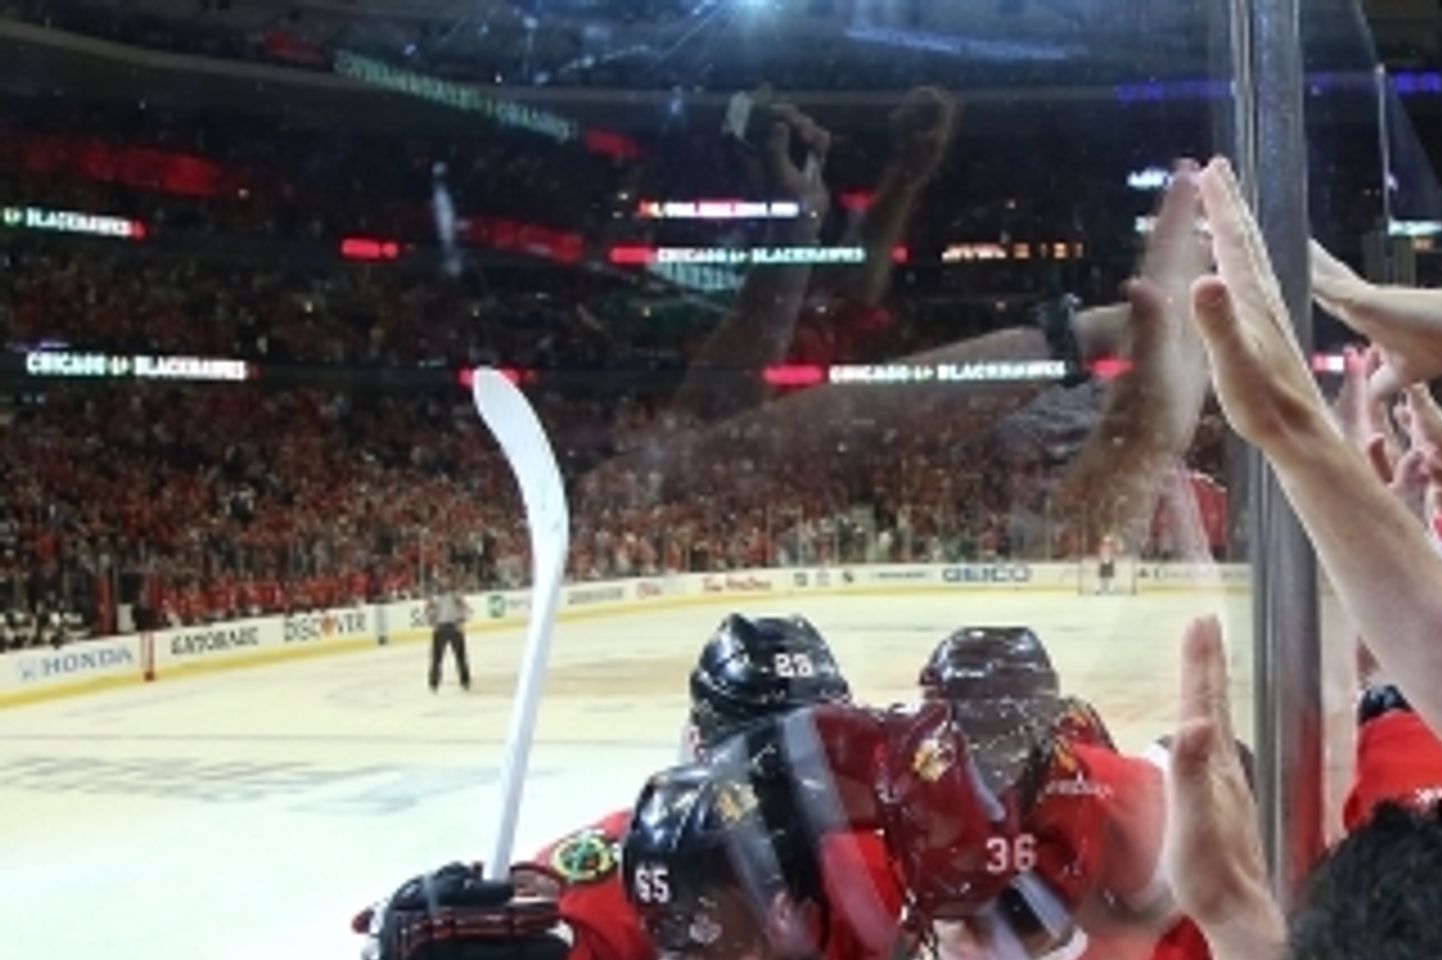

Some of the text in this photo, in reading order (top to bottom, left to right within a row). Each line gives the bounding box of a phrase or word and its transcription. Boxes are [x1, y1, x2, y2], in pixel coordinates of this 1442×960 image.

[283, 612, 366, 642] DISCOVER
[41, 647, 133, 677] HONDA
[986, 833, 1037, 873] 36
